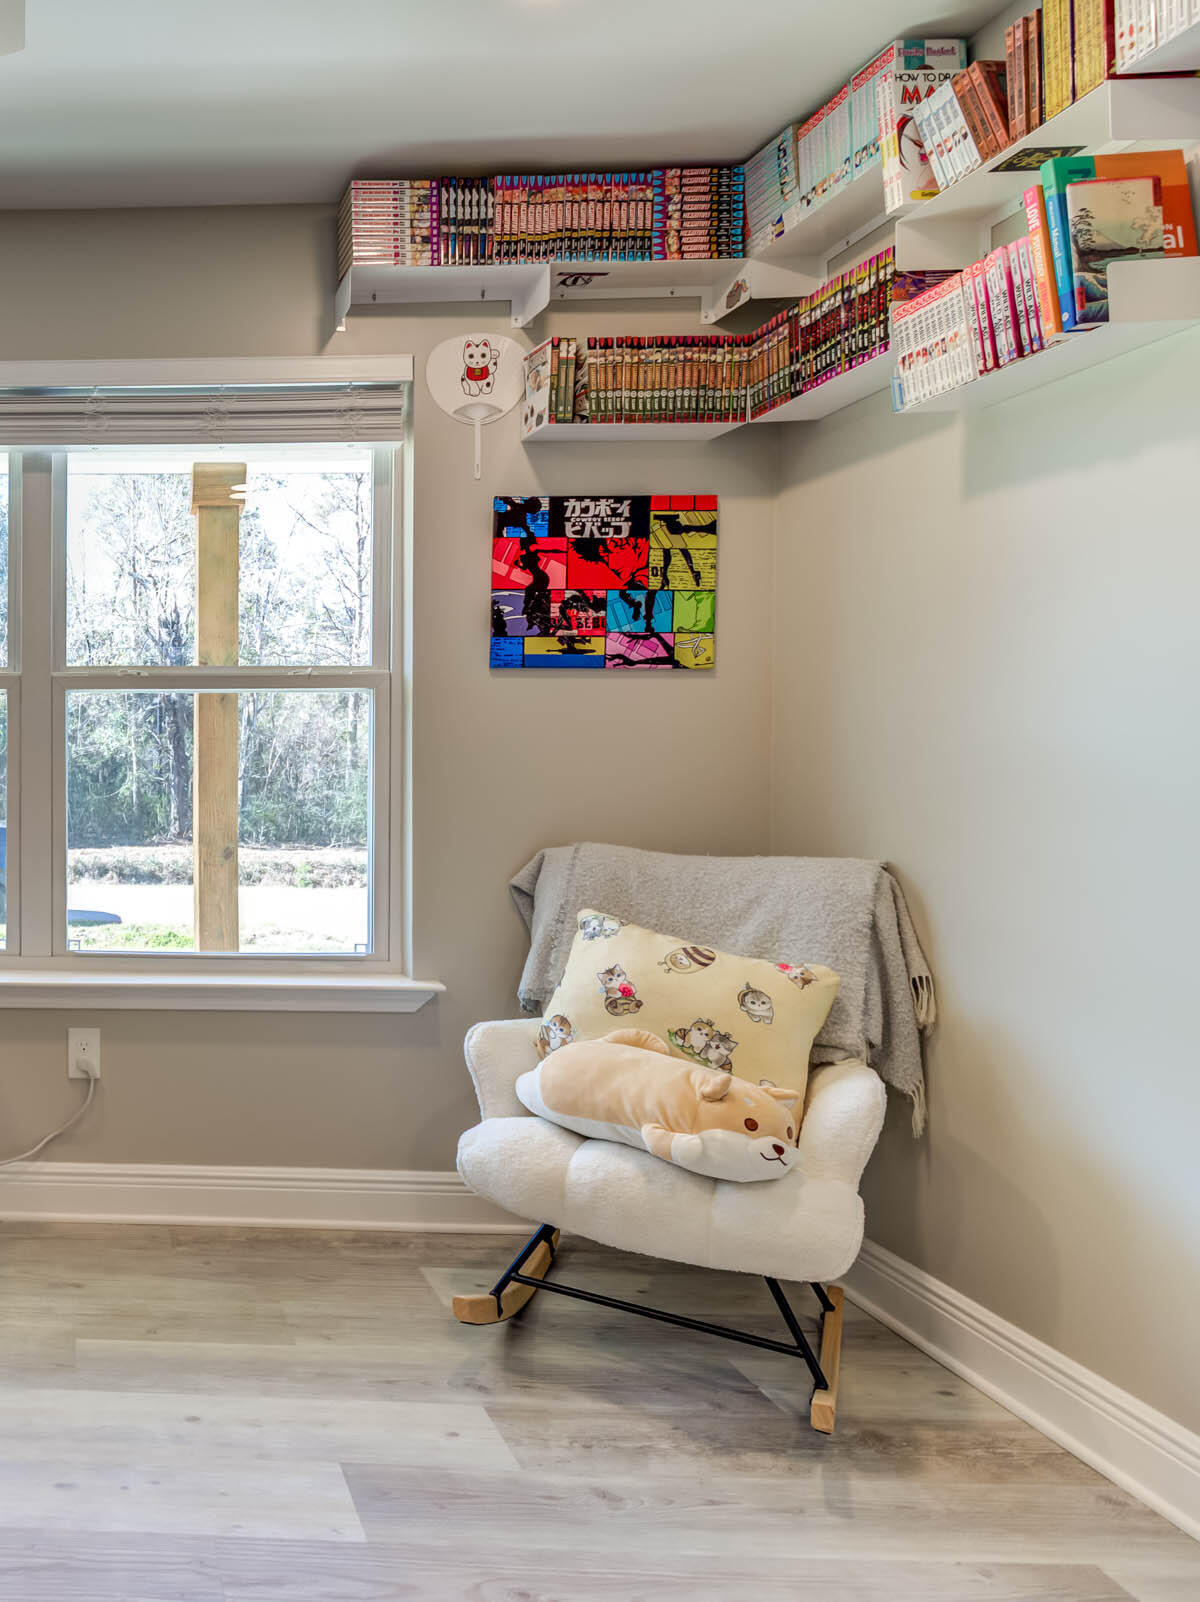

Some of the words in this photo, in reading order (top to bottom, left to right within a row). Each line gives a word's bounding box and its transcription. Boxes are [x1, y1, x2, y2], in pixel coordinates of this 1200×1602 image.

[895, 72, 919, 82] HOW
[922, 72, 937, 82] TO
[1026, 203, 1041, 231] LOVE
[1001, 289, 1009, 313] WILD
[1015, 284, 1023, 308] WILD
[1025, 279, 1033, 302] WILD
[563, 498, 632, 518] カウボーイ
[563, 521, 632, 539] ビバップ
